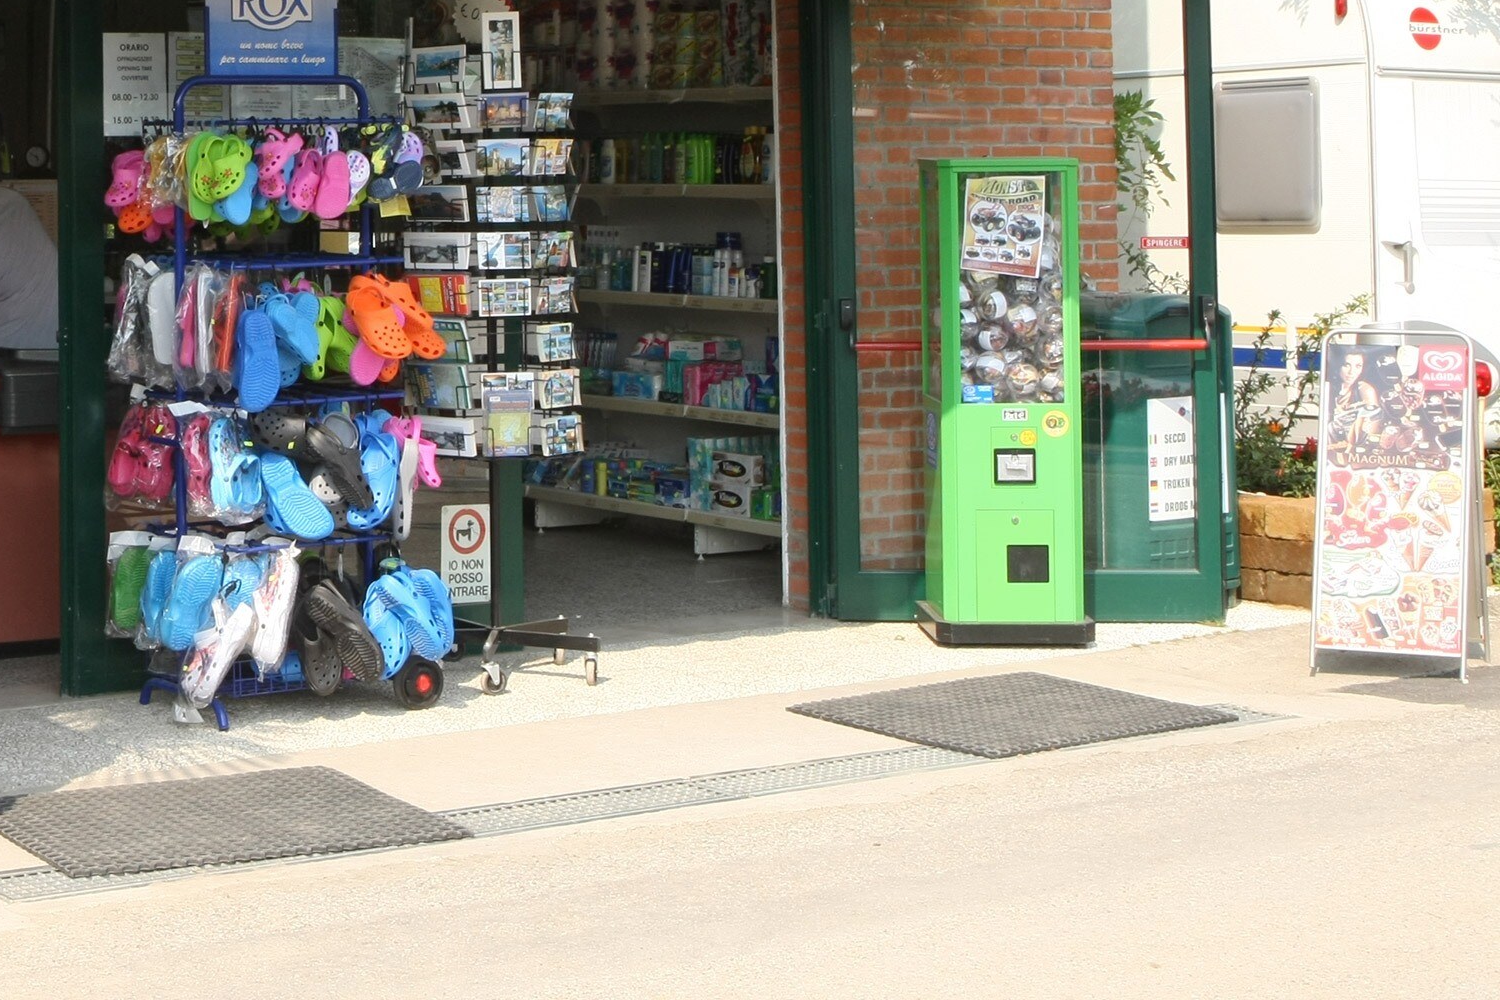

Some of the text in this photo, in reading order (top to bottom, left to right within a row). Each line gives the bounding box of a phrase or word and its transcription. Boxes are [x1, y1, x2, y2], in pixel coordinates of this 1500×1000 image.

[1409, 23, 1465, 34] bürstner
[240, 39, 304, 49] un nome breve
[219, 56, 236, 66] per
[239, 55, 289, 64] camminare
[301, 54, 326, 66] lungo
[112, 93, 132, 101] 08.00
[140, 93, 159, 101] 12.30
[113, 116, 133, 124] 15.00
[1146, 239, 1183, 247] SPINGERE
[1423, 373, 1462, 381] ALGIDA
[1164, 433, 1186, 444] SECCO
[1164, 456, 1177, 467] DRY
[1348, 453, 1408, 465] MAGNUM
[1163, 478, 1190, 490] TROKEN
[448, 558, 484, 571] IO NON
[448, 572, 483, 584] POSSO
[449, 584, 489, 599] NTRARE
